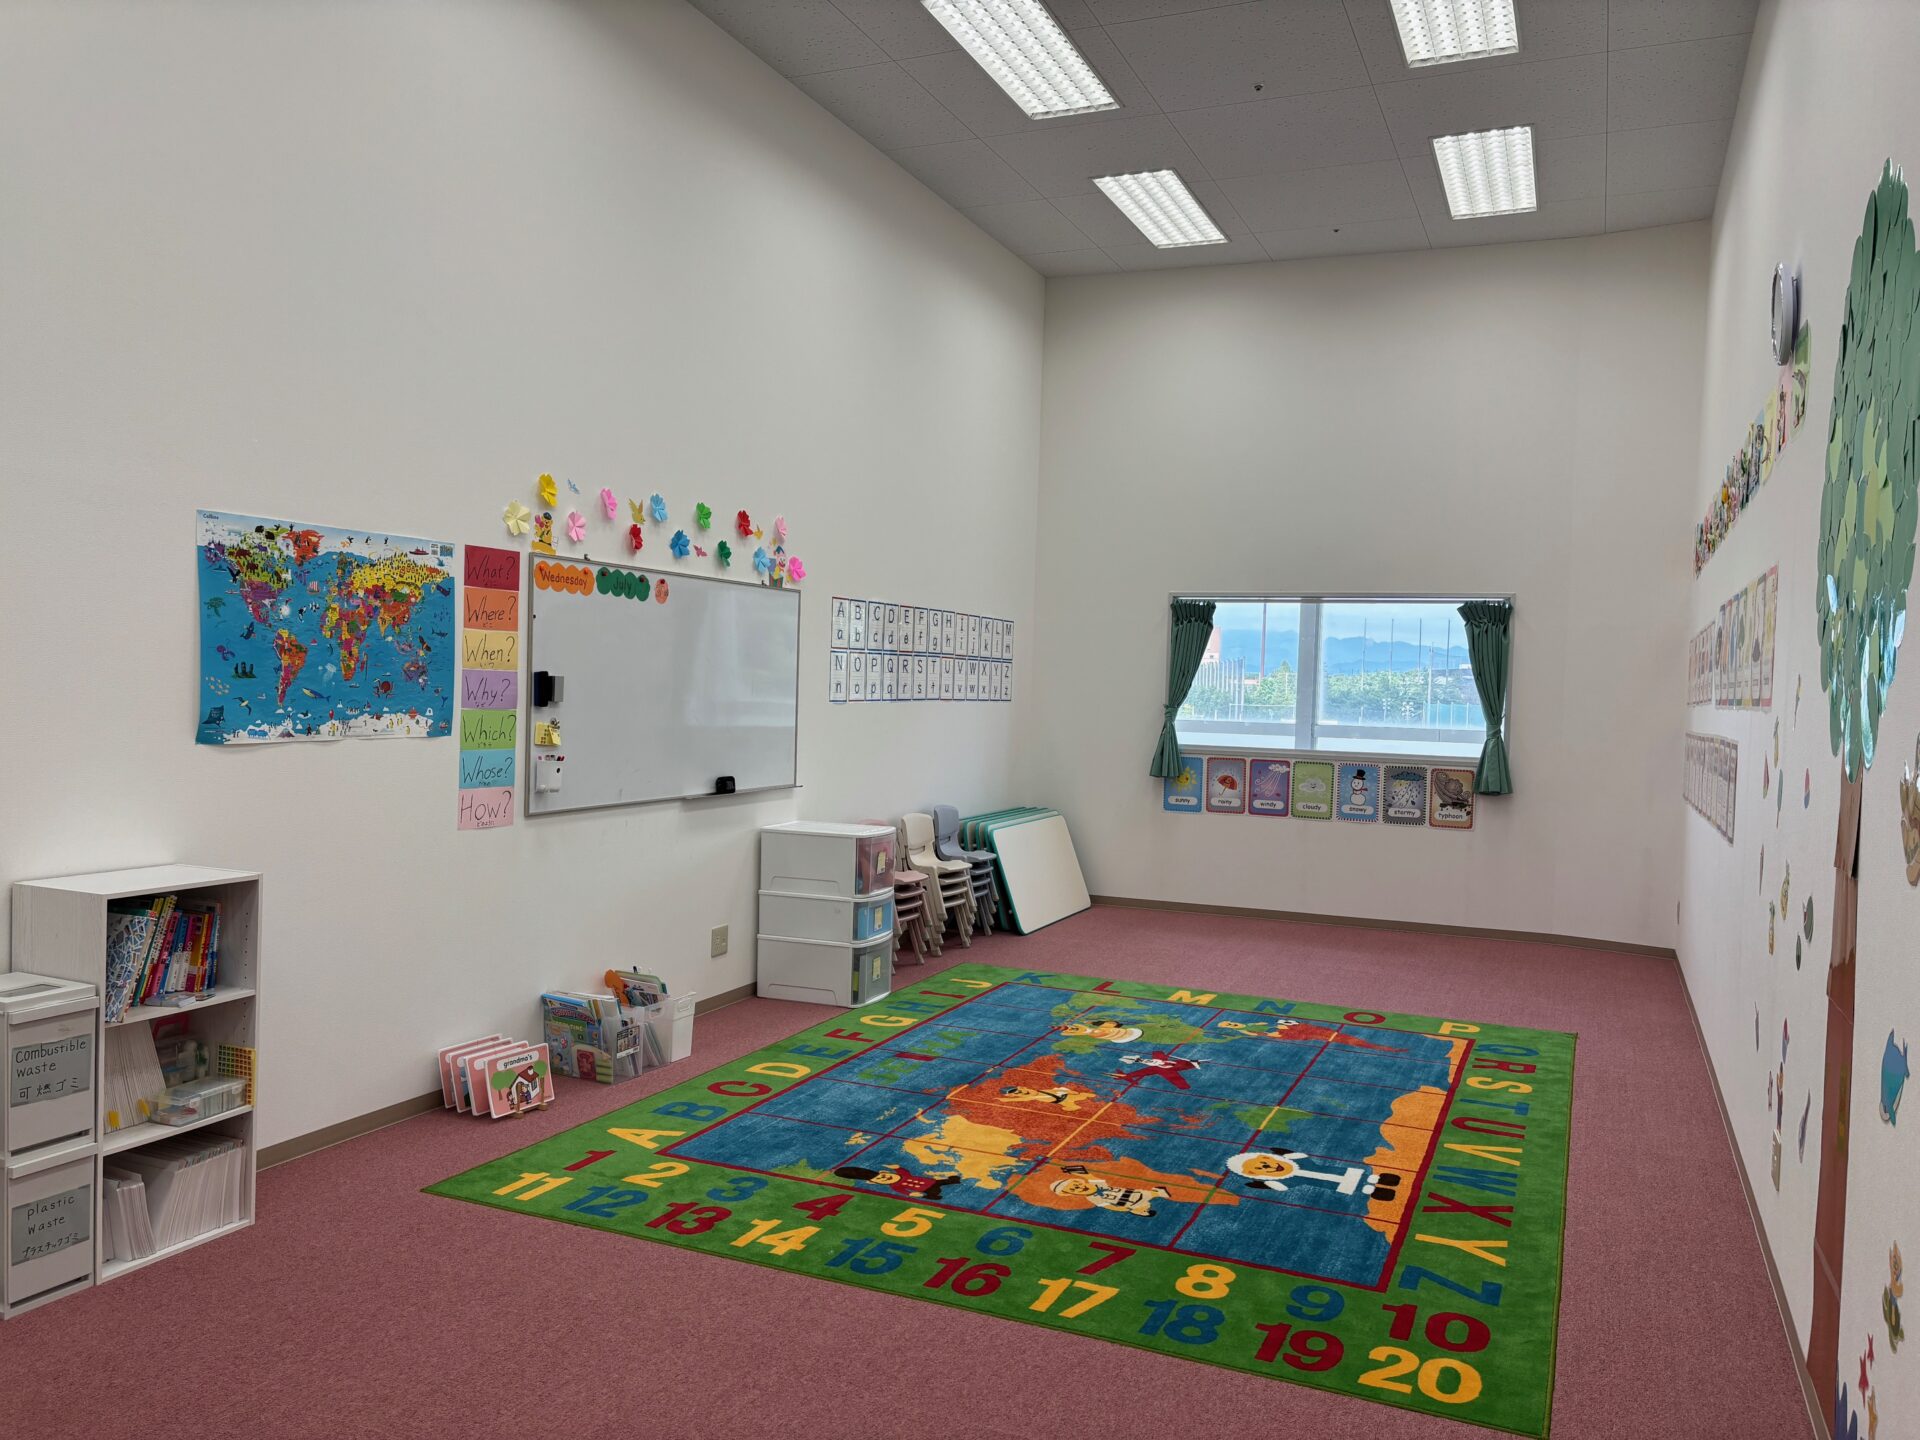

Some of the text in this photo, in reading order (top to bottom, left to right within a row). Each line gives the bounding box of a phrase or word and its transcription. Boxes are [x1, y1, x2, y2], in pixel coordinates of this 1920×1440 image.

[465, 551, 516, 580] What?
[541, 569, 588, 590] Wednesday
[613, 579, 632, 594] July
[466, 593, 517, 623] Where?
[837, 602, 844, 618] A
[855, 605, 861, 620] B
[874, 606, 880, 620] C
[889, 609, 894, 623] D
[905, 610, 909, 624] E
[918, 612, 924, 625] F
[933, 613, 939, 626] G
[946, 616, 951, 628] H
[972, 619, 976, 631] J
[985, 621, 989, 633] K
[996, 623, 999, 634] L
[1006, 624, 1011, 635] M
[465, 633, 515, 663] When?
[836, 656, 1009, 677] N O P Q R S T U V W X Y Z
[465, 675, 511, 706] Why?
[462, 714, 517, 743] Which?
[462, 755, 513, 784] Whose?
[460, 790, 512, 824] How?
[1014, 972, 1481, 1035] K L M N O P
[16, 1039, 86, 1063] Combustible
[503, 1055, 533, 1068] grandma's
[607, 978, 992, 1149] A B C D E F G H I J
[1472, 1057, 1537, 1074] R
[19, 1077, 79, 1099] 可燃ゴミ
[1466, 1076, 1533, 1094] S
[1459, 1098, 1530, 1116] T
[1451, 1116, 1527, 1140] U
[1443, 1143, 1523, 1166] V
[1432, 1165, 1518, 1197] W
[1422, 1191, 1515, 1228] X
[563, 1150, 1491, 1353] 1 2 3 4 5 6 7 8 9 10
[1414, 1233, 1508, 1267] Y
[492, 1171, 1483, 1404] 11 12 13 14 15 16 17 18 19 20
[1398, 1264, 1503, 1307] Z
